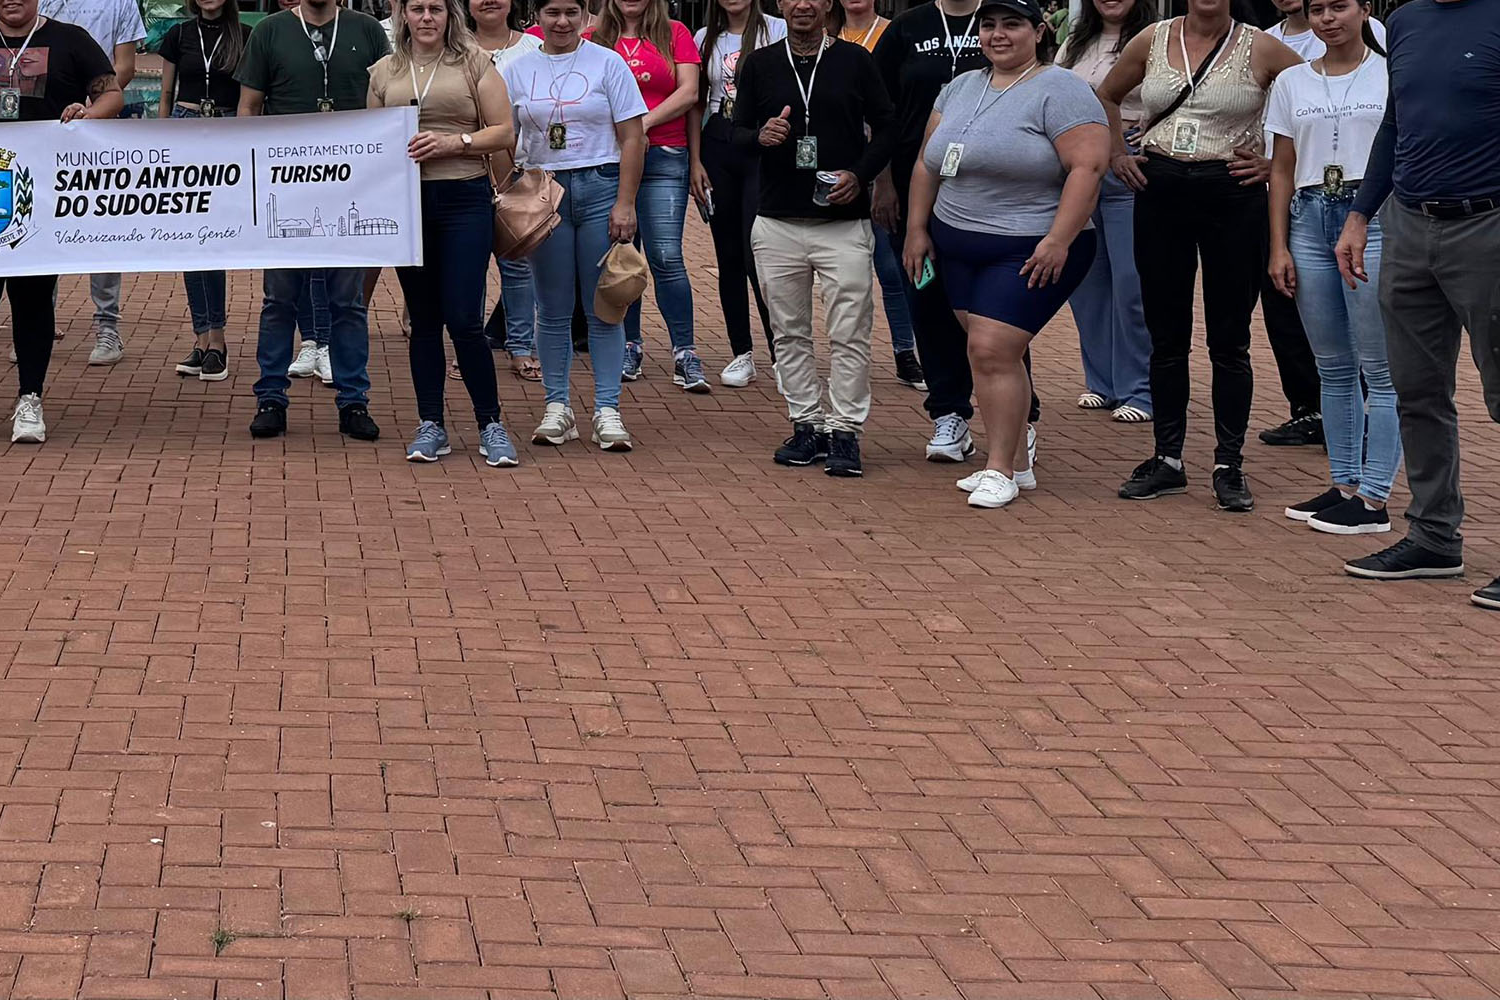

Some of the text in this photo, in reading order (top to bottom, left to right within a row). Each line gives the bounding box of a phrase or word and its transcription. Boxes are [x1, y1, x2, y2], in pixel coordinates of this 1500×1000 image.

[915, 35, 982, 53] LOS ANGEL
[1295, 106, 1325, 117] Calvin
[1353, 102, 1383, 110] Jeans
[56, 147, 171, 167] MUNICÍPIO DE
[268, 143, 383, 158] DEPARTAMENTO DE
[54, 163, 241, 191] SANTO ANTONIO
[271, 163, 351, 184] TURISMO
[54, 191, 212, 217] DO SUDOESTE
[54, 225, 242, 245] Valorizando Nossa Gente!
